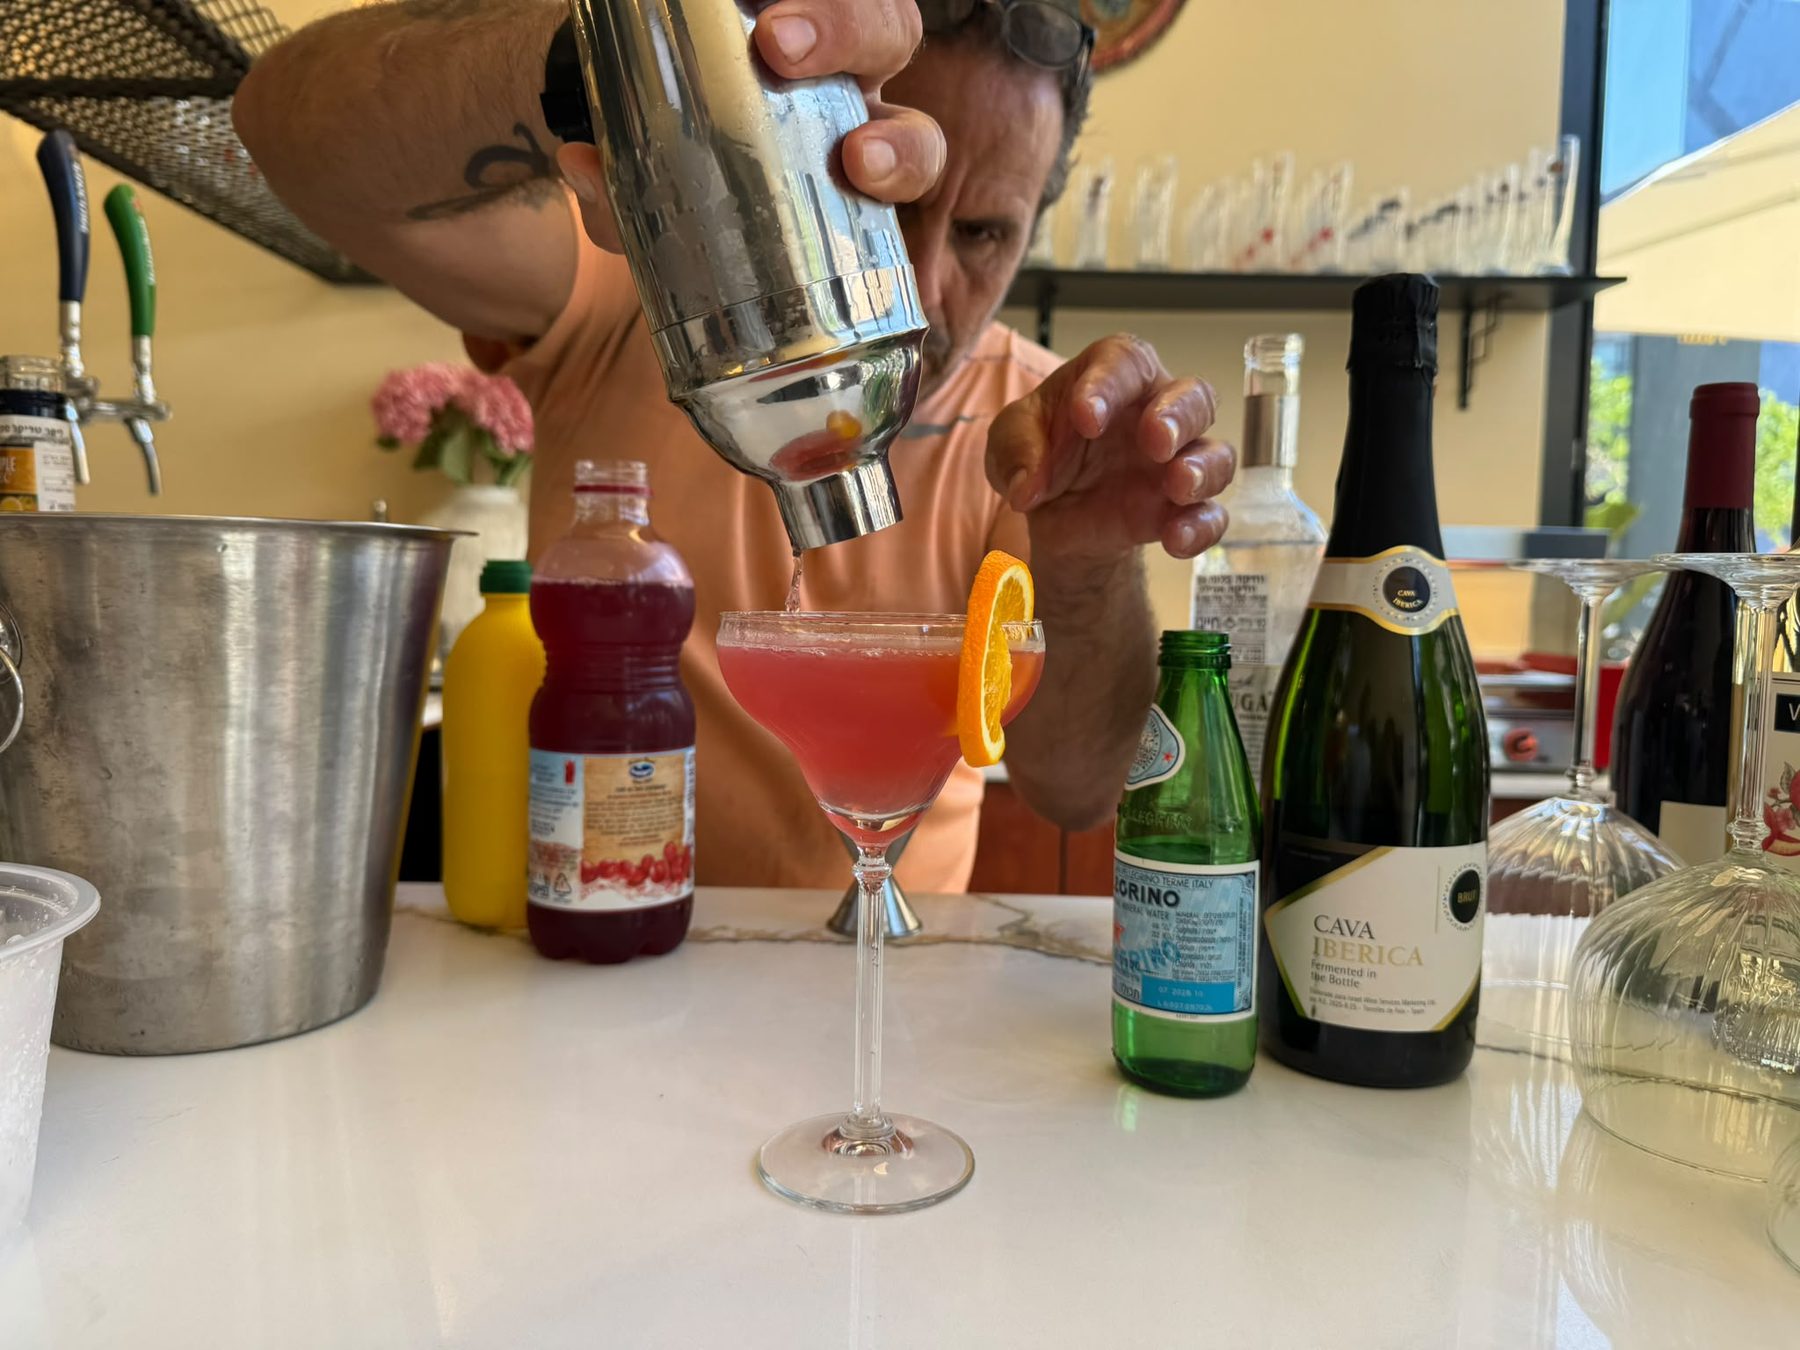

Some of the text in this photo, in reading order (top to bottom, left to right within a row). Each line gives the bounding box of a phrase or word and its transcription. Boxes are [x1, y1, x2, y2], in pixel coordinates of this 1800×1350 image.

[1162, 877, 1189, 888] TERME
[1191, 880, 1214, 889] ITALY
[1457, 888, 1478, 903] BRUT
[1313, 914, 1375, 940] CAVA
[1313, 936, 1424, 967] IBERICA
[1311, 959, 1377, 979] Fermented in
[1311, 970, 1361, 989] the Bottle
